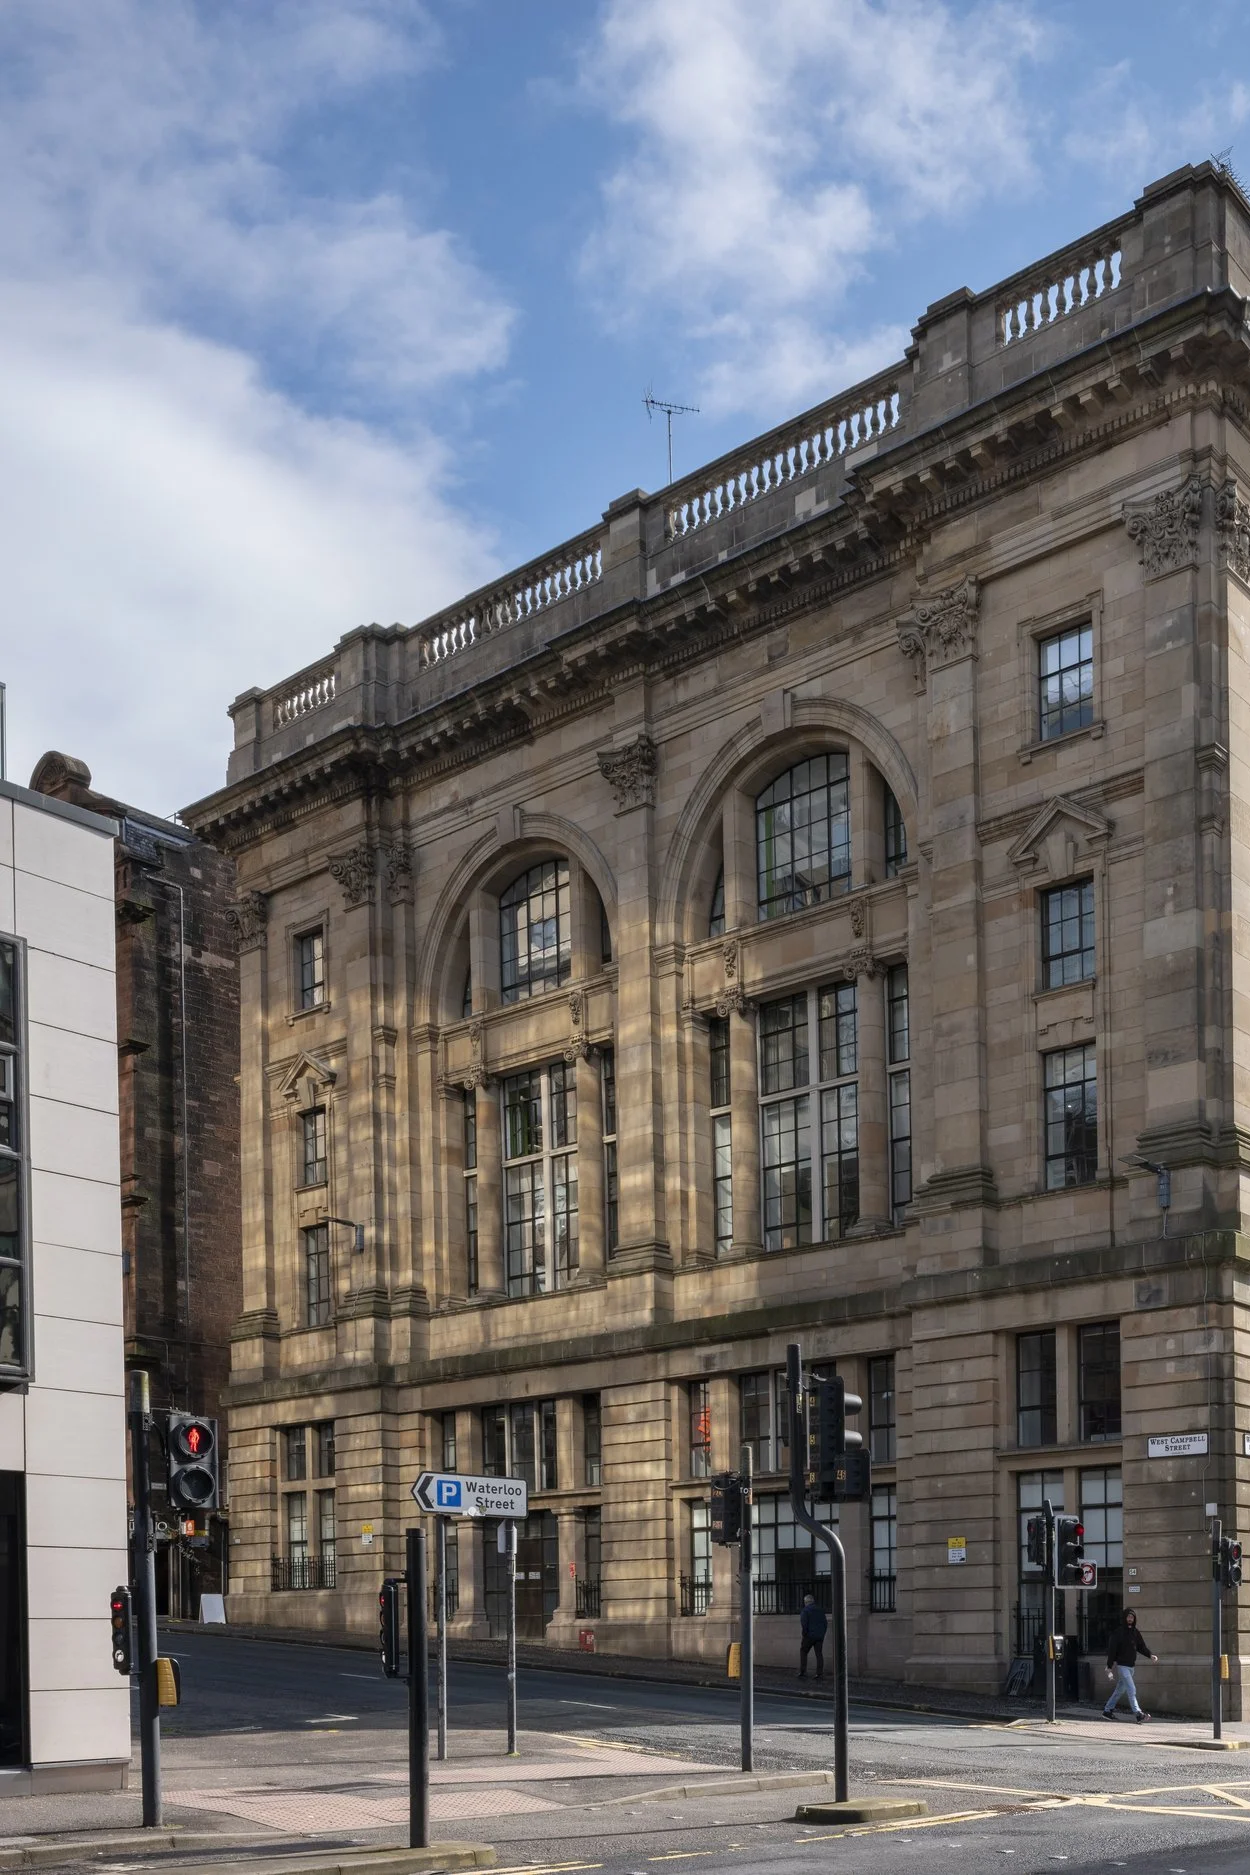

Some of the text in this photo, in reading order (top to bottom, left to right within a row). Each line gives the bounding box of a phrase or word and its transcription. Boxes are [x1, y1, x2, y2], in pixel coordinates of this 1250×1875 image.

[1170, 1435, 1206, 1444] CAMPBELL
[1164, 1444, 1191, 1452] STREET
[442, 1483, 457, 1504] P
[466, 1481, 522, 1496] Waterloo
[475, 1496, 515, 1510] Street
